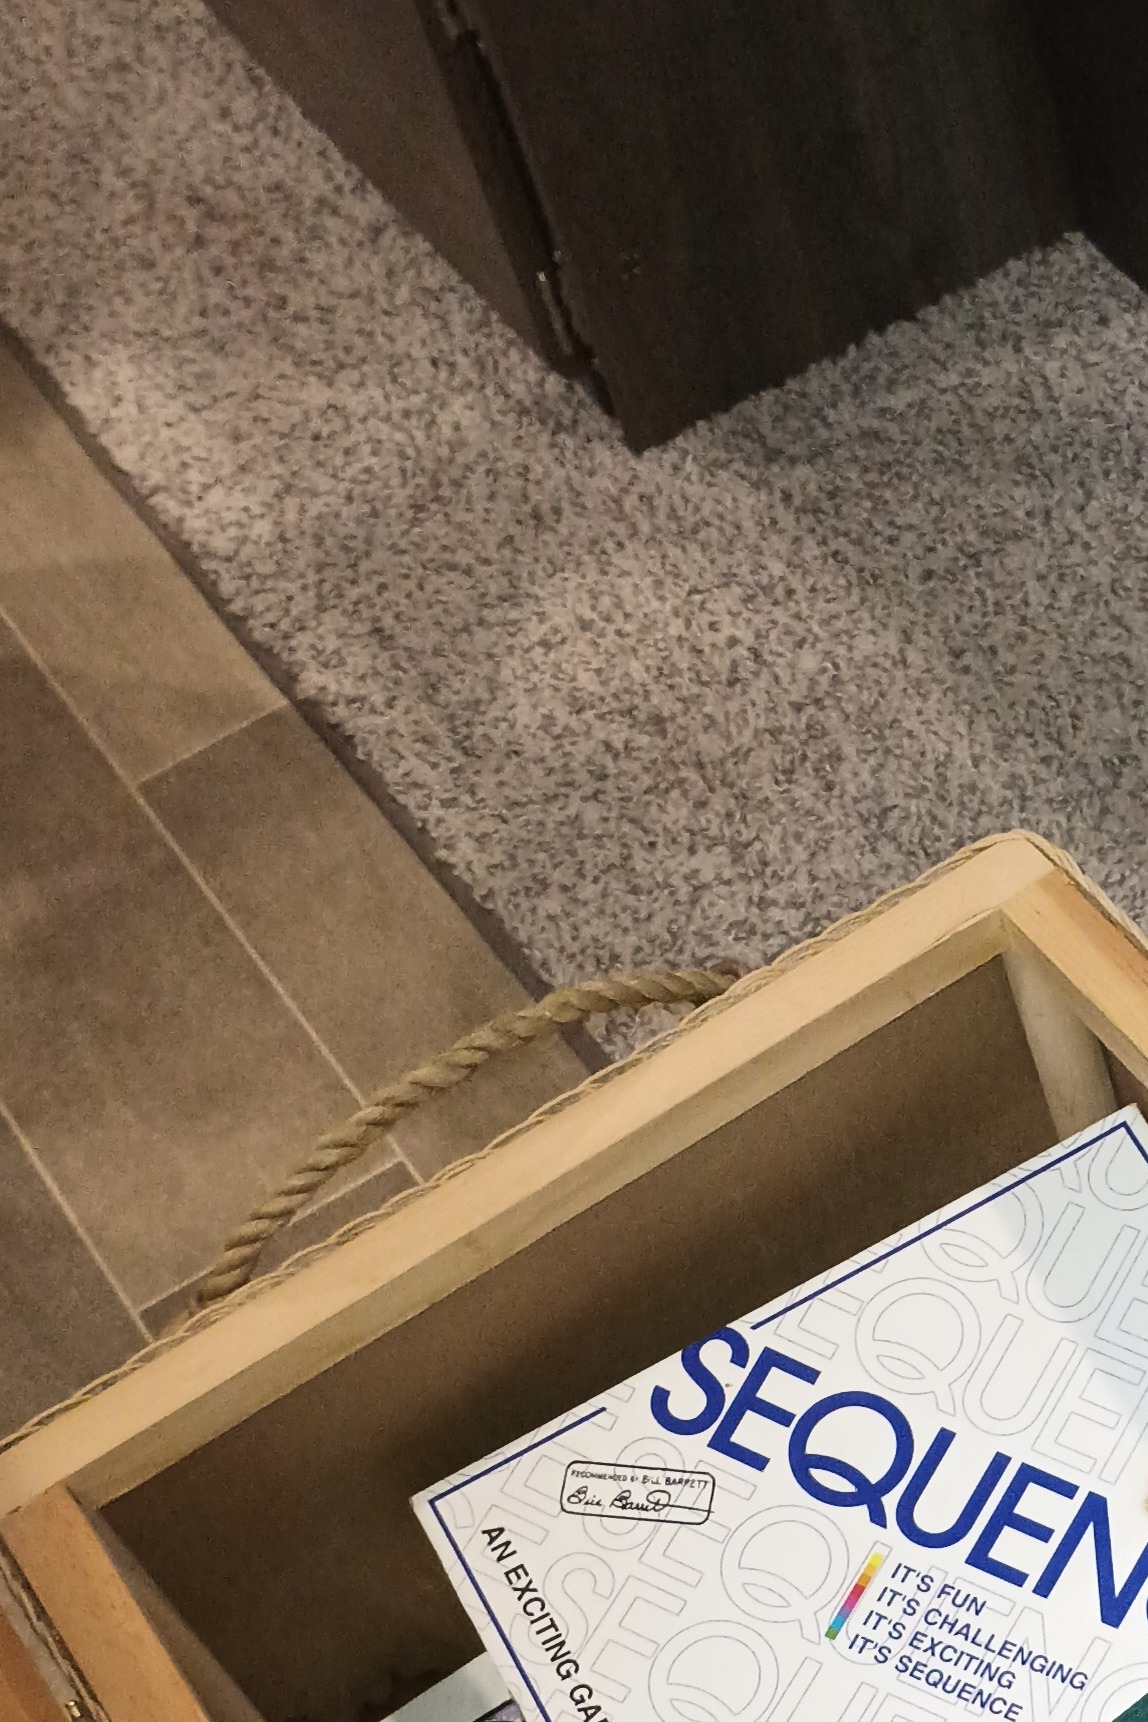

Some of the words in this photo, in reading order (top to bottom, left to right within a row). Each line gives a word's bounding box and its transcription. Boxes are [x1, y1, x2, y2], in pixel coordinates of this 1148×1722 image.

[481, 1525, 518, 1564] AN
[503, 1563, 580, 1682] EXCITING
[890, 1562, 935, 1593] IT'S
[936, 1583, 987, 1616] FUN
[848, 1633, 892, 1664] IT'S
[894, 1654, 1024, 1722] SEQUENCE
[862, 1609, 906, 1641] IT'S
[908, 1631, 1016, 1690] EXCITING
[876, 1586, 921, 1617] IT'S
[923, 1607, 1089, 1691] CHALLENGING
